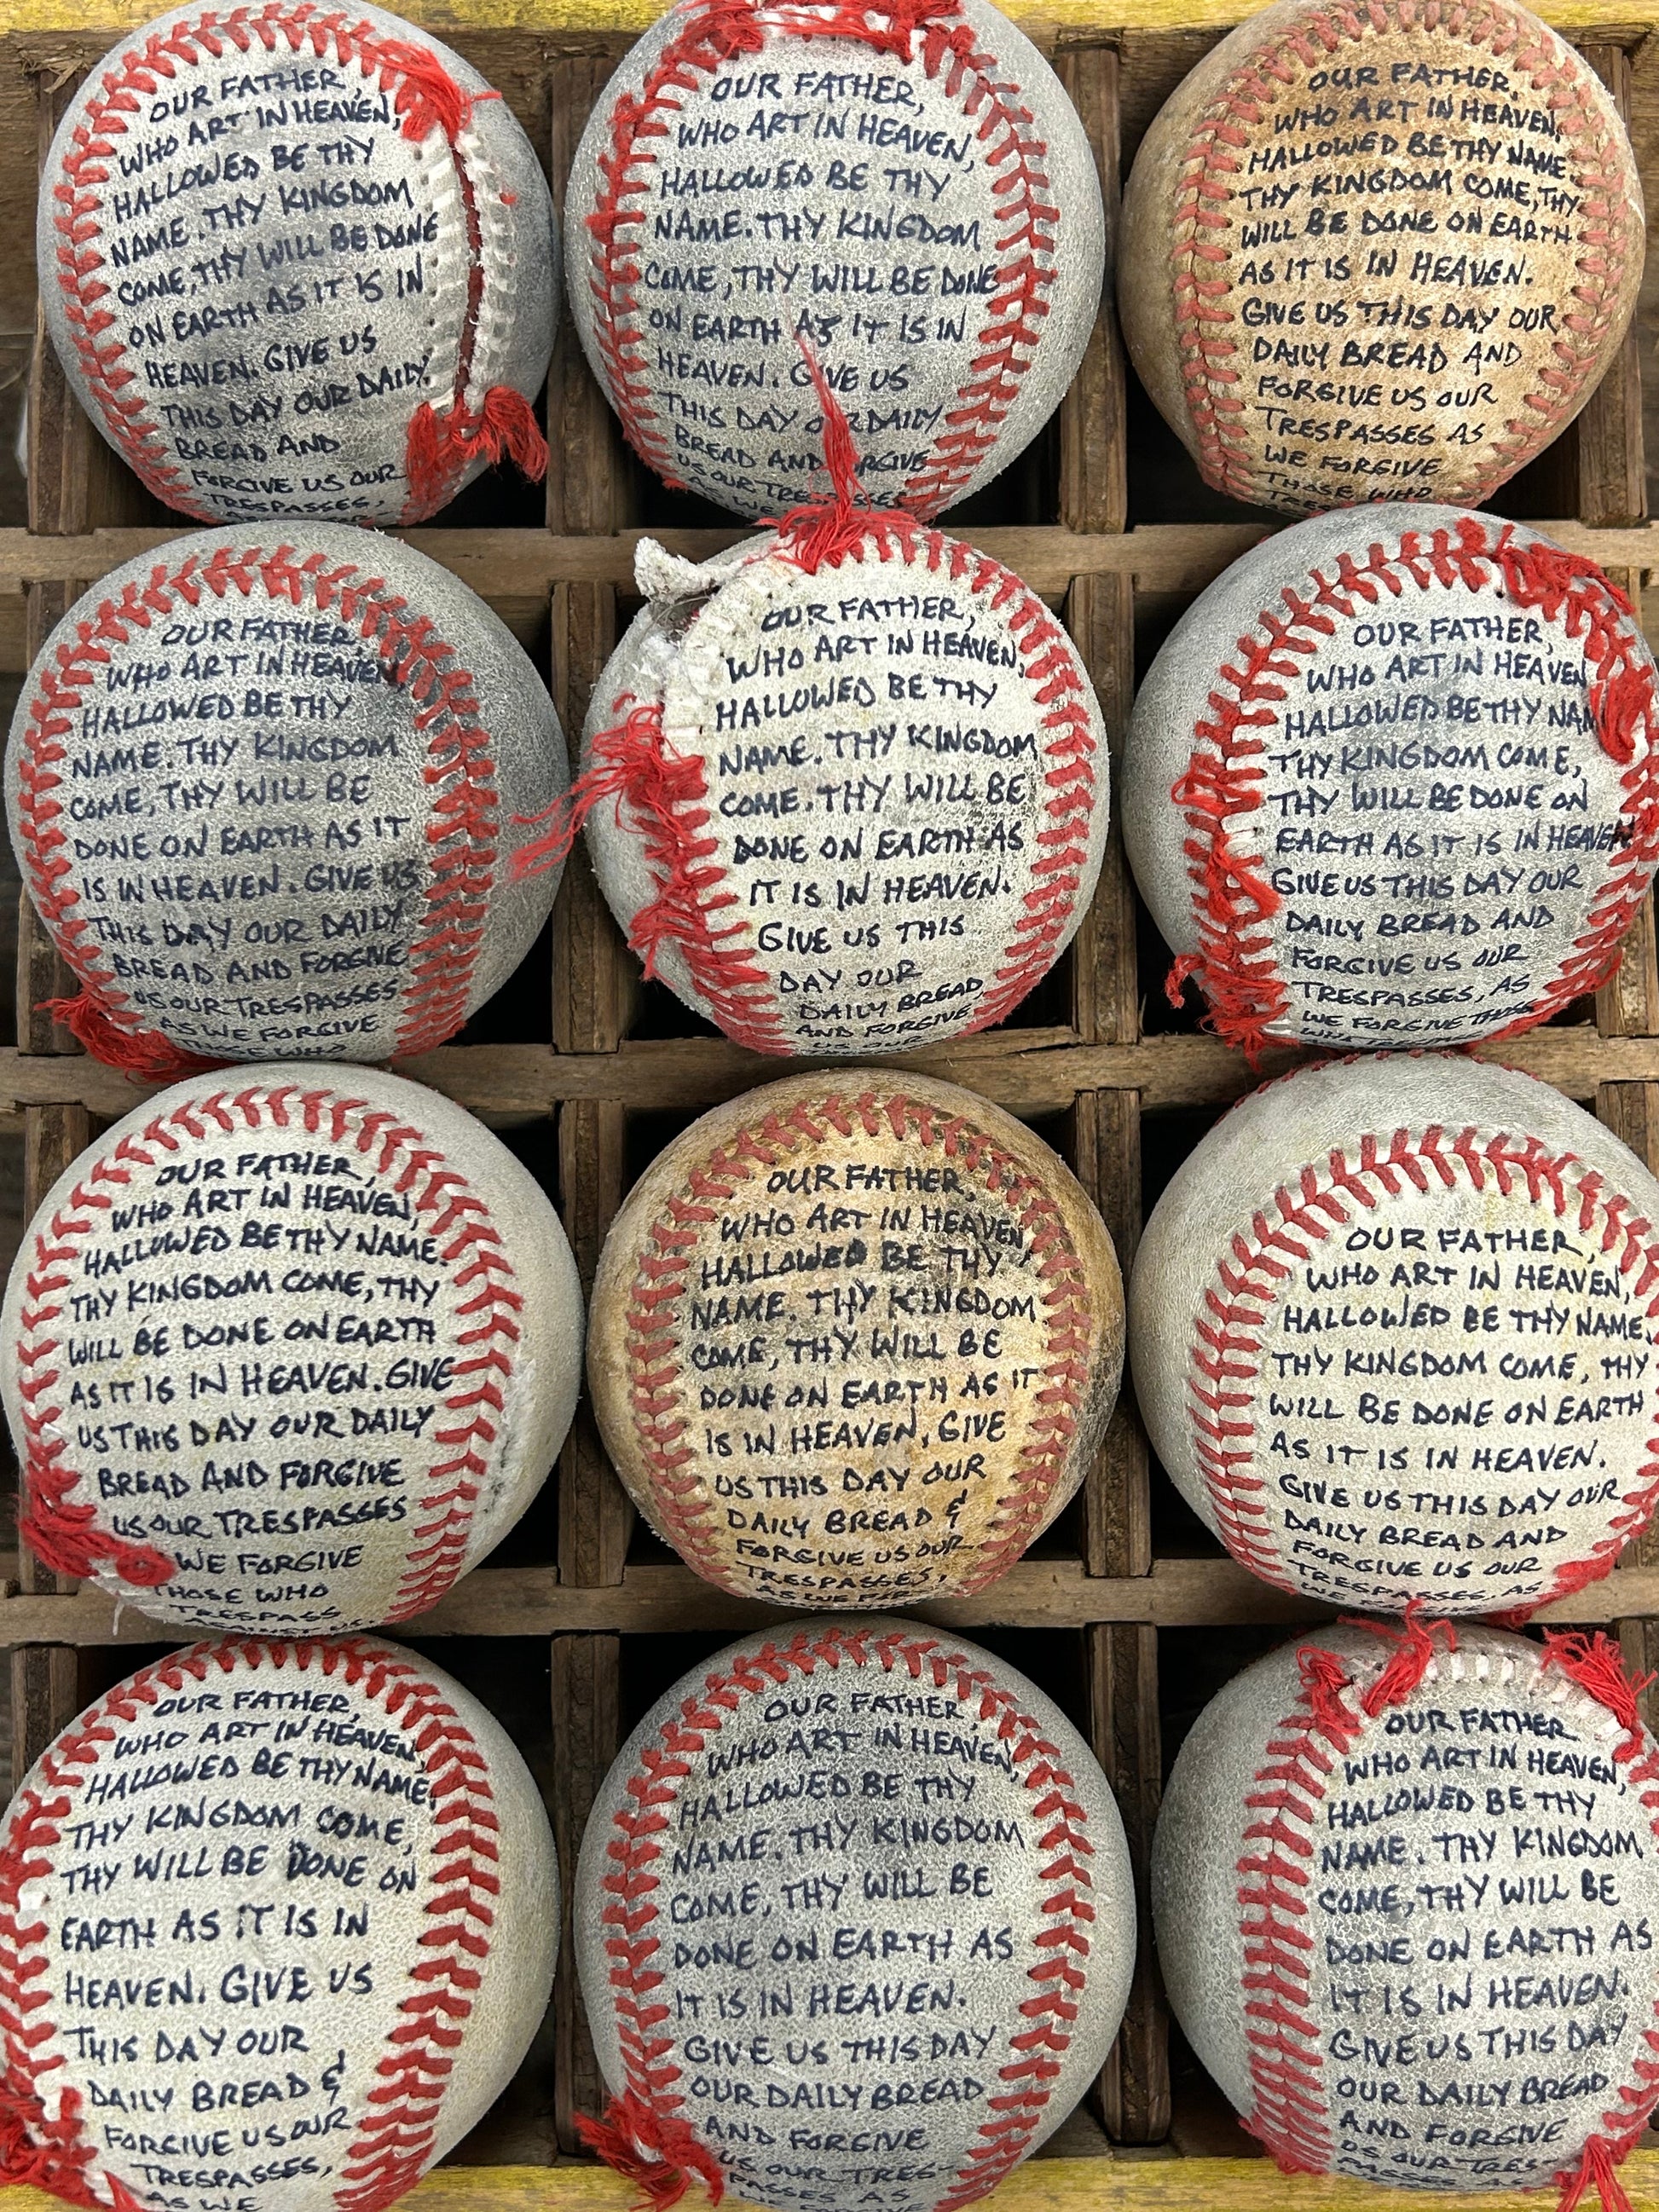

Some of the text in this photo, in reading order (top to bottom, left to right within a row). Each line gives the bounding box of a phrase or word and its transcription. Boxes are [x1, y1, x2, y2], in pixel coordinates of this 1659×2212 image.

[711, 72, 925, 114] OUR FATHER,
[1308, 63, 1518, 101] OUR FATHER,
[150, 84, 212, 123] OUR
[114, 136, 374, 222] HALLOWED BE THY
[661, 161, 950, 200] HALLOWED BE THY
[1240, 251, 1533, 286] AS IT IS IN HEAVEN.
[649, 305, 966, 347] ON EARTH AS IT IS IN
[147, 326, 376, 387] HEAVEN. GIVE US
[658, 346, 779, 388] HEAVEN.
[870, 364, 910, 390] US
[1255, 407, 1485, 444] TRESPASSES AS
[176, 435, 340, 460] BREAD AND
[1265, 445, 1442, 476] WE FORGIVE
[303, 474, 344, 492] US
[350, 464, 408, 486] OUR
[1258, 471, 1354, 500] THOSE
[162, 618, 235, 646] OUR
[762, 597, 975, 631] OUR FATHER,
[1354, 617, 1552, 656] OUR FATHER,
[716, 673, 997, 731] HALLOWED BE THY
[1269, 743, 1586, 783] THY KINGDOM COME,
[70, 772, 370, 820] COME, THY WILL BE
[73, 817, 411, 860] DONE ON EARTH AS IT
[749, 863, 1011, 910] IT IS IN HEAVEN.
[1286, 905, 1554, 939] DAILY BREAD AND
[780, 960, 923, 994] DAY OUR
[1292, 944, 1529, 977] FORGIVE US OUR
[171, 994, 230, 1016] OUR
[225, 979, 398, 1019] TRESPASSES
[800, 978, 984, 1020] DAILY BREAD,
[1292, 976, 1530, 1007] TRESPASSES, AS
[155, 1152, 376, 1188] OUR FATHER,
[768, 1164, 975, 1200] OUR FATHER,
[1346, 1228, 1595, 1263] OUR FATHER,
[70, 1311, 435, 1366] WILL BE DONE ON EARTH
[691, 1326, 1003, 1371] COME, THY WILL BE
[1270, 1432, 1607, 1473] AS IT IS IN HEAVEN.
[99, 1459, 405, 1499] BREAD AND FORGIVE
[715, 1453, 987, 1499] US THIS DAY OUR
[726, 1509, 810, 1538] DAILY
[824, 1507, 933, 1534] BREAD
[1284, 1509, 1568, 1551] DAILY BREAD AND
[175, 1546, 365, 1576] WE FORGIVE
[1292, 1542, 1542, 1578] FORGIVE US OUR
[153, 1689, 360, 1722] OUR FATHER,
[765, 1695, 837, 1722] OUR
[1385, 1709, 1455, 1735] OUR
[63, 1799, 414, 1854] THY KINGDOM COME,
[1327, 1786, 1595, 1829] HALLOWED BE THY
[62, 1903, 368, 1951] EARTH AS IT IS IN
[674, 1927, 1014, 1969] DONE ON EARTH AS
[1331, 1969, 1629, 2017] IT IS IN HEAVEN.
[691, 2076, 984, 2110] OUR DAILY BREAD
[1337, 2071, 1609, 2107] OUR DAILY BREAD
[130, 2157, 332, 2189] TRESPASSES,
[719, 2150, 757, 2172] US
[766, 2163, 846, 2182] OUR
